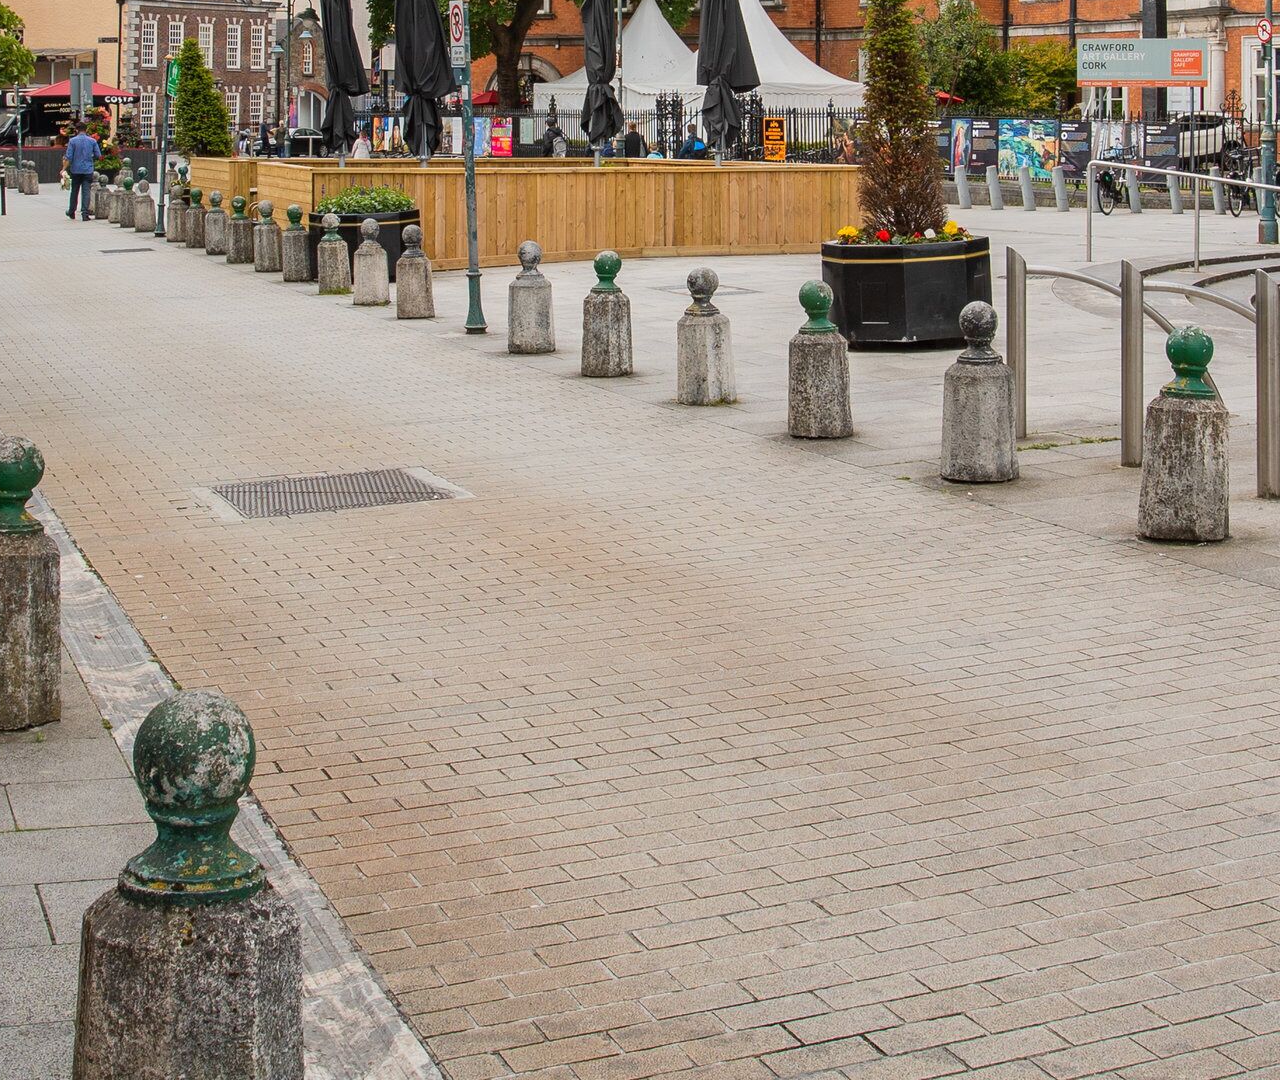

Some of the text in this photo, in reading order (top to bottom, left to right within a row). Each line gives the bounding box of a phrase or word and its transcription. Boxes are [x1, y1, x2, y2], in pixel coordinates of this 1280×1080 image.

[1081, 43, 1135, 52] CRAWFORD
[1081, 52, 1146, 61] ART GALLERY
[1081, 61, 1107, 70] CORK
[104, 95, 134, 104] COSTA
